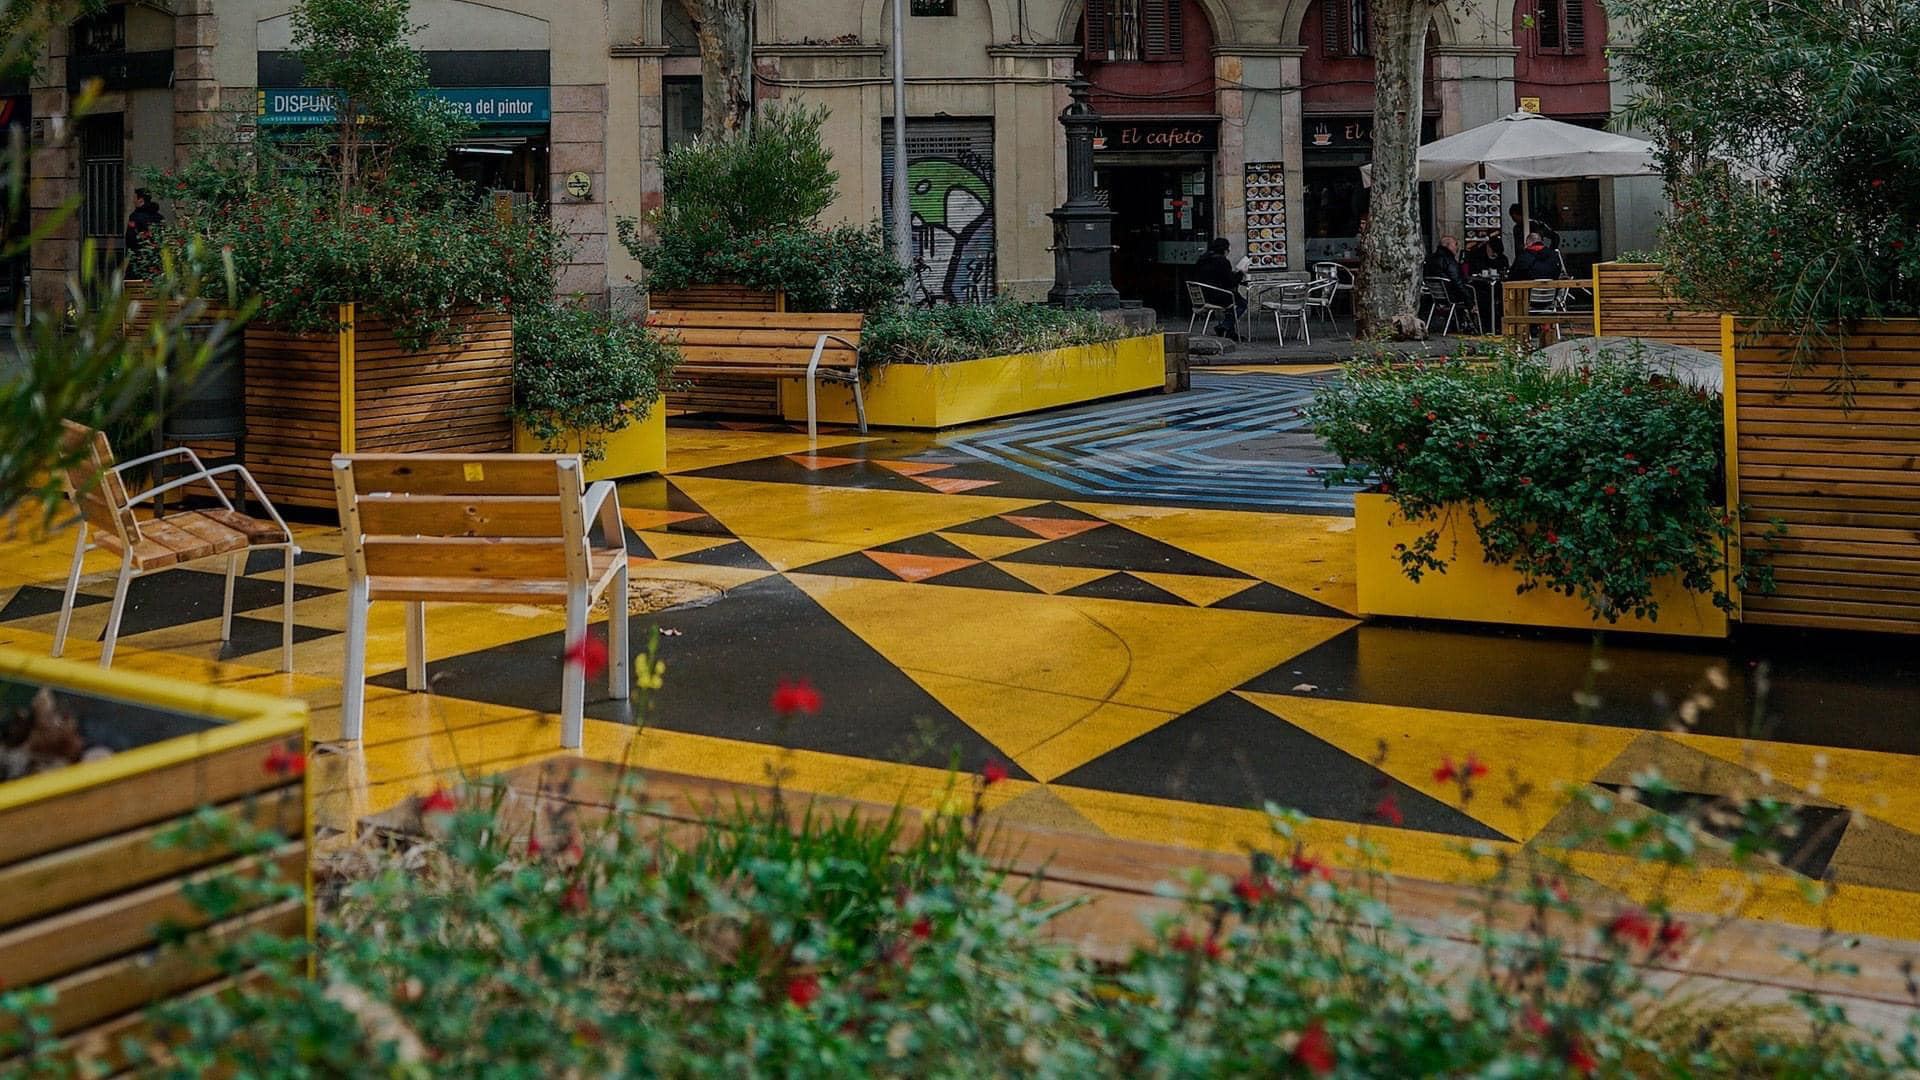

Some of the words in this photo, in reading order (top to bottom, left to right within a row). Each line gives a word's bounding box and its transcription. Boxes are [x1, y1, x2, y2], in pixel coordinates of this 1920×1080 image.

[475, 99, 494, 114] del
[498, 99, 533, 117] pintor
[1121, 127, 1141, 144] El
[1344, 122, 1363, 140] El
